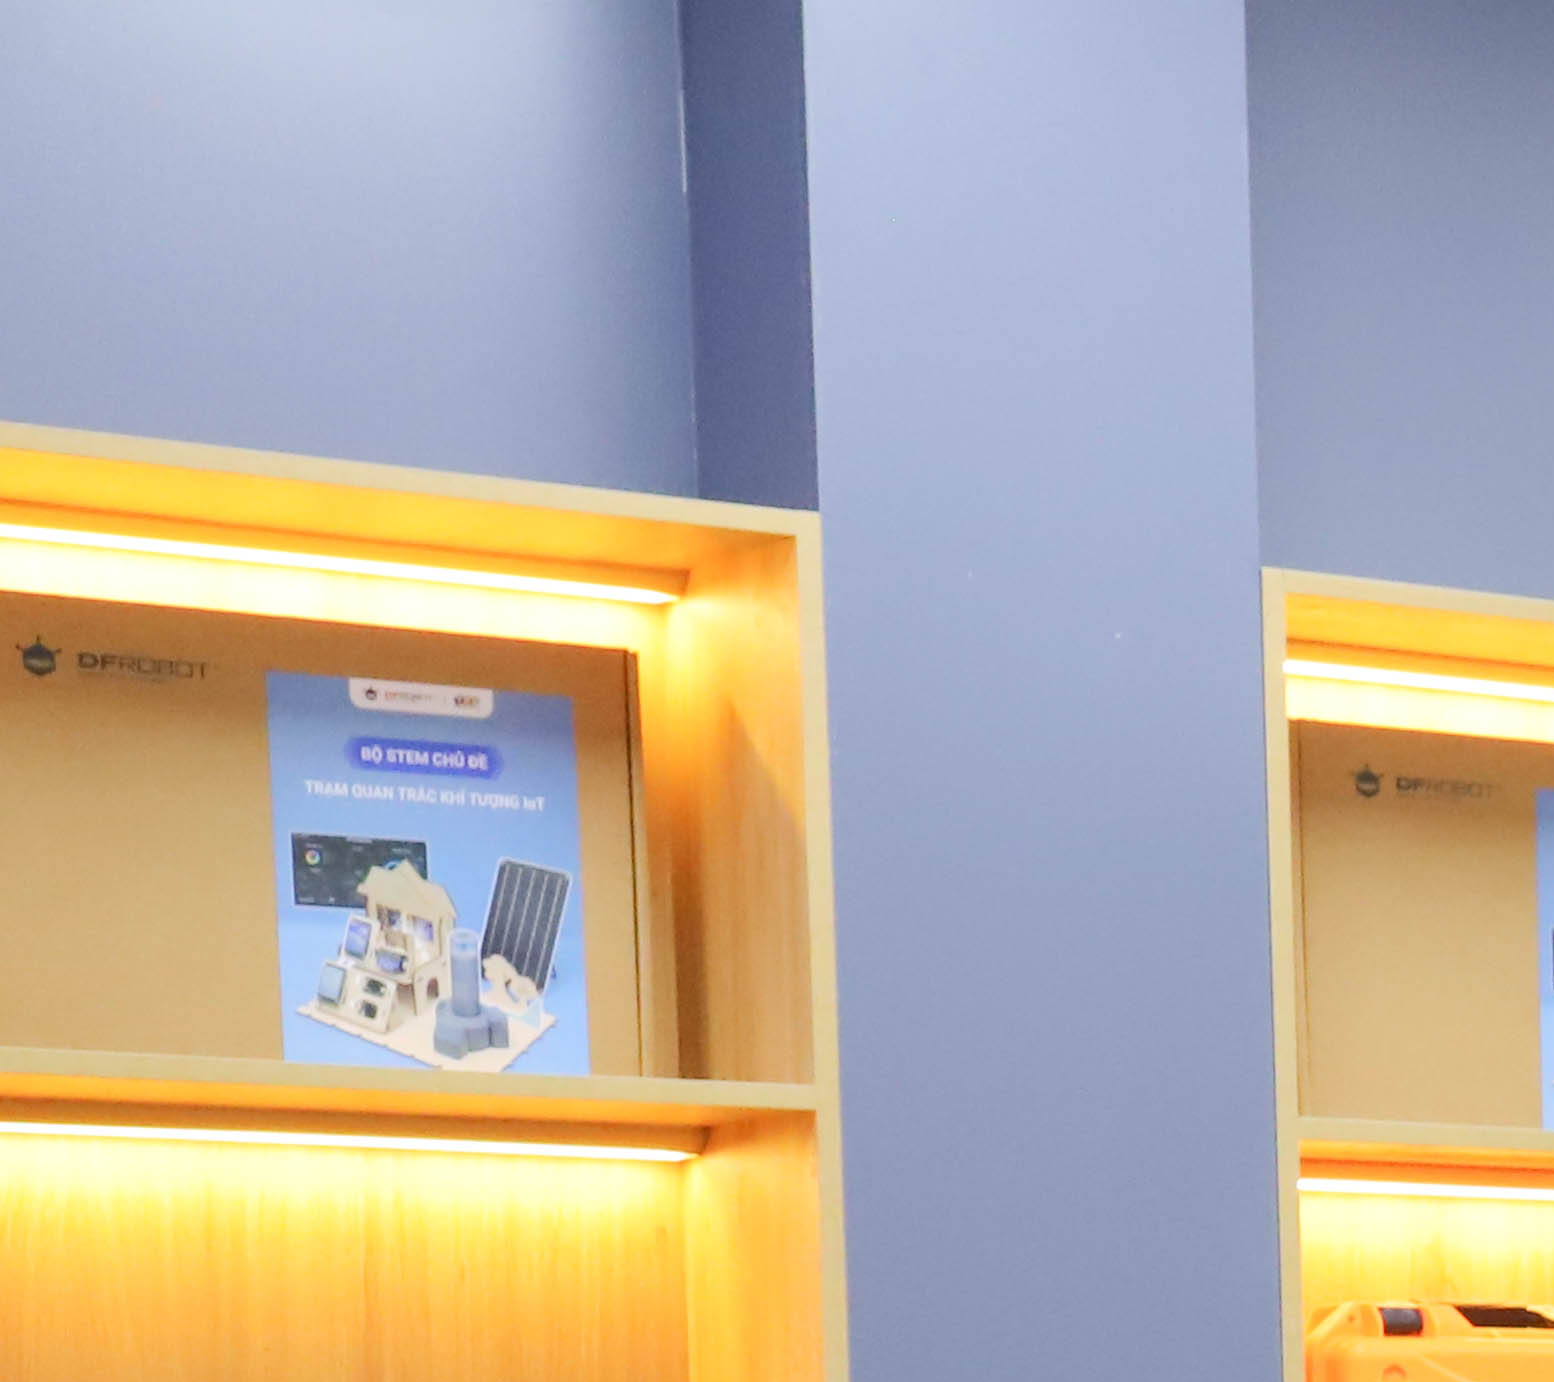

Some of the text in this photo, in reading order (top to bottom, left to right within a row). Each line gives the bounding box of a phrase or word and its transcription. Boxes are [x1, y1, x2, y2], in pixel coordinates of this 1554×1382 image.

[360, 744, 384, 765] BỘ
[386, 746, 430, 768] STEM
[351, 783, 395, 801] QUAN
